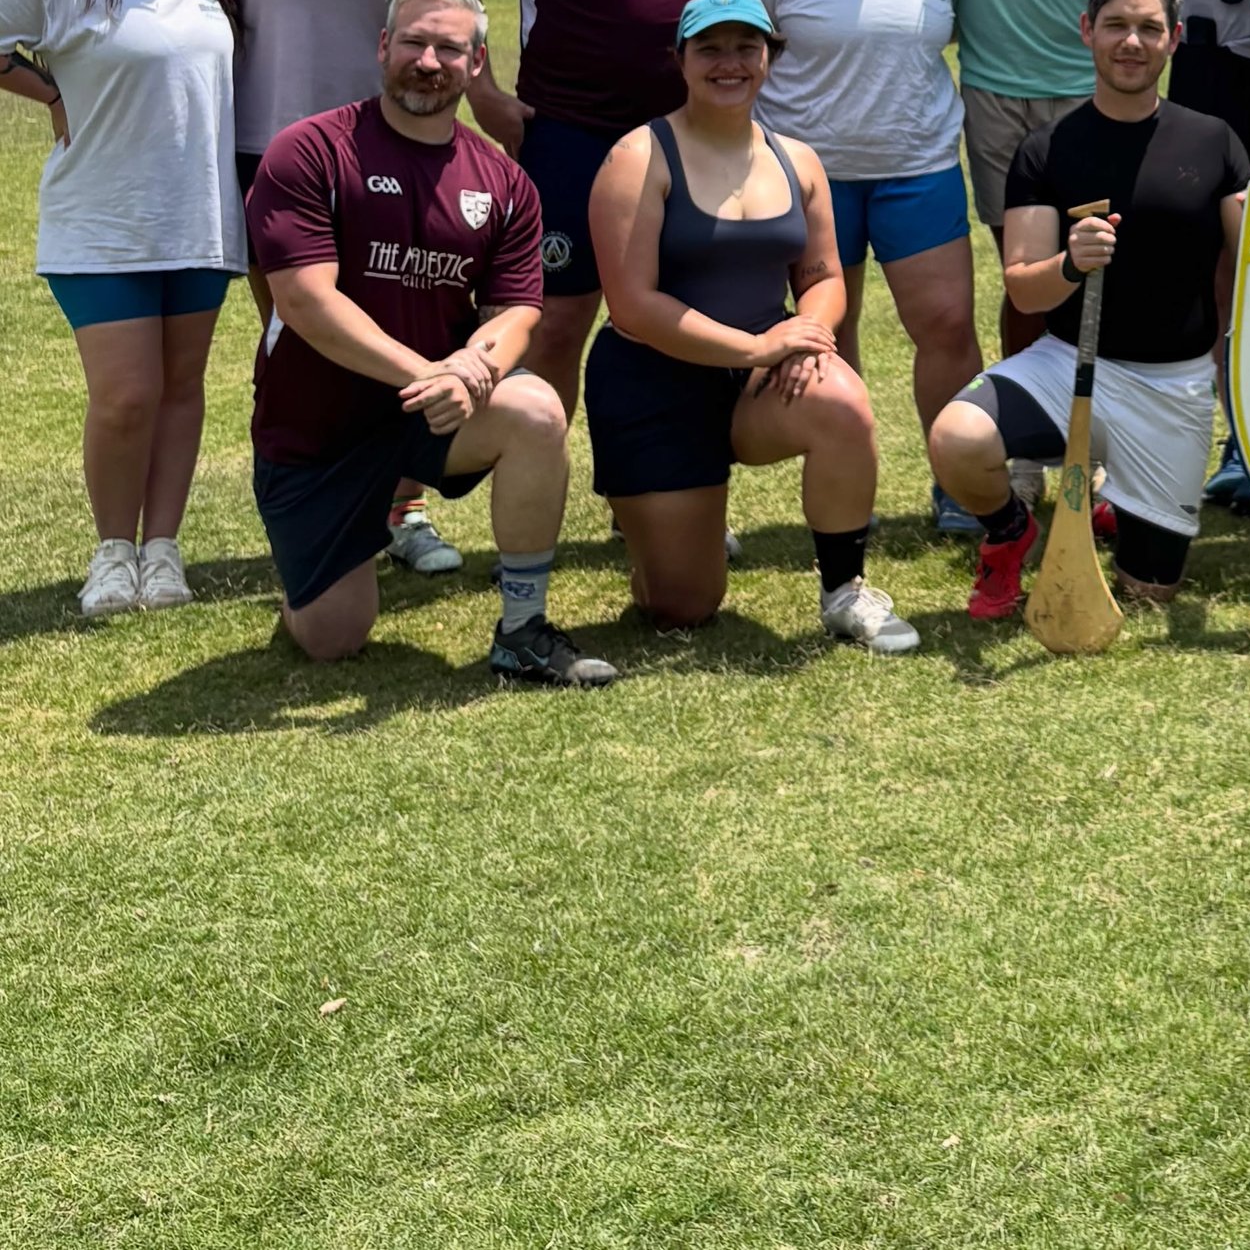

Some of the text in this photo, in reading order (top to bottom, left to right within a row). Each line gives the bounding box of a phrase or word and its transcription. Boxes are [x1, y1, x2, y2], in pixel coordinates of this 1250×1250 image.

[367, 175, 403, 195] GAA
[369, 241, 474, 282] THE MAJESTIC
